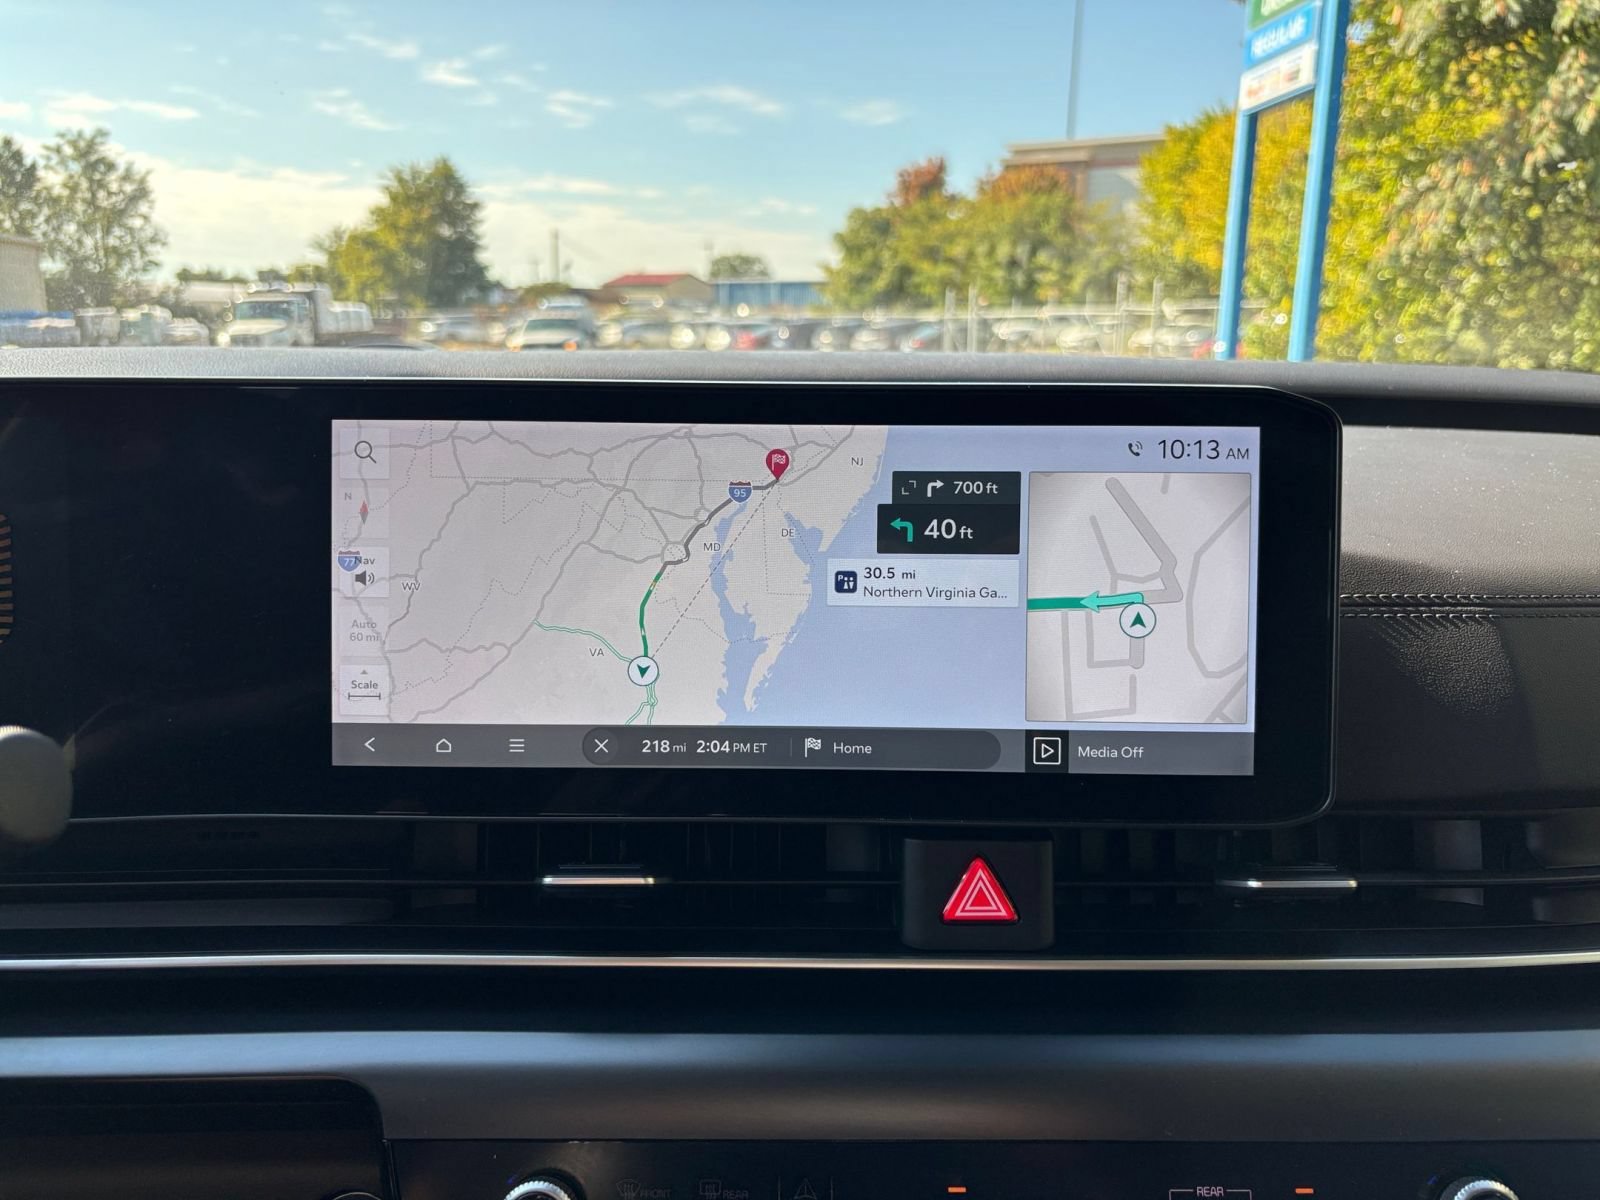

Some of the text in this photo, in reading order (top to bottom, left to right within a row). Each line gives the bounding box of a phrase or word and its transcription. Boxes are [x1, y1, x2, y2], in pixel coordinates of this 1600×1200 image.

[1158, 439, 1249, 460] 10:13 AM
[851, 456, 864, 467] NJ
[734, 487, 746, 498] 95
[953, 480, 998, 495] 700 ft
[781, 528, 795, 538] DE
[924, 518, 973, 540] 40 ft
[703, 542, 721, 553] MD
[355, 556, 375, 566] Nav
[863, 567, 916, 580] 30.5 mi
[402, 581, 421, 592] WV
[863, 585, 1008, 602] Northern Virginia Ga...
[351, 619, 377, 630] Auto
[349, 632, 365, 642] 60
[589, 646, 605, 657] VA
[350, 679, 379, 690] Scale
[642, 740, 768, 754] 218 mi 2:04 PM ET
[833, 742, 873, 755] Home
[1078, 746, 1144, 758] Media Off
[1197, 1187, 1224, 1197] REAR
